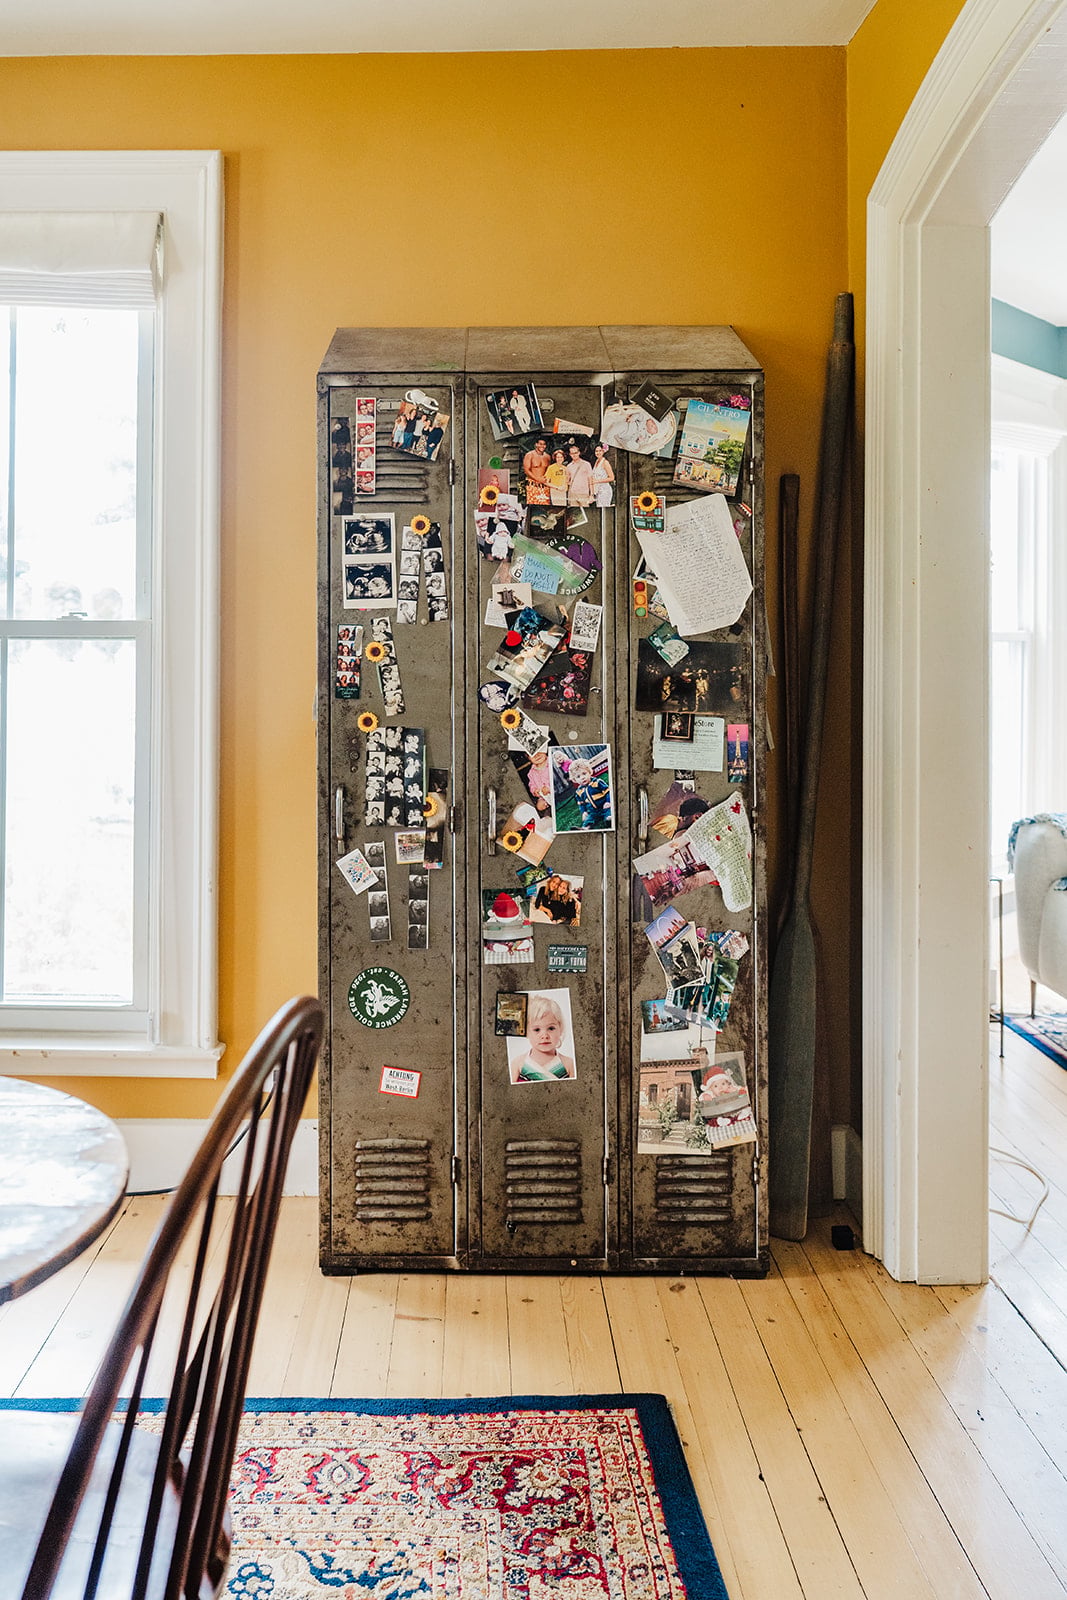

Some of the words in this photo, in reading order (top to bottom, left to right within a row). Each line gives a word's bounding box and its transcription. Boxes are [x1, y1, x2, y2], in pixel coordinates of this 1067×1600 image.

[560, 569, 597, 595] LAWRENCE
[389, 971, 409, 996] SARAH
[349, 996, 373, 1027] COLLEGE
[375, 998, 409, 1029] LAWRENCE
